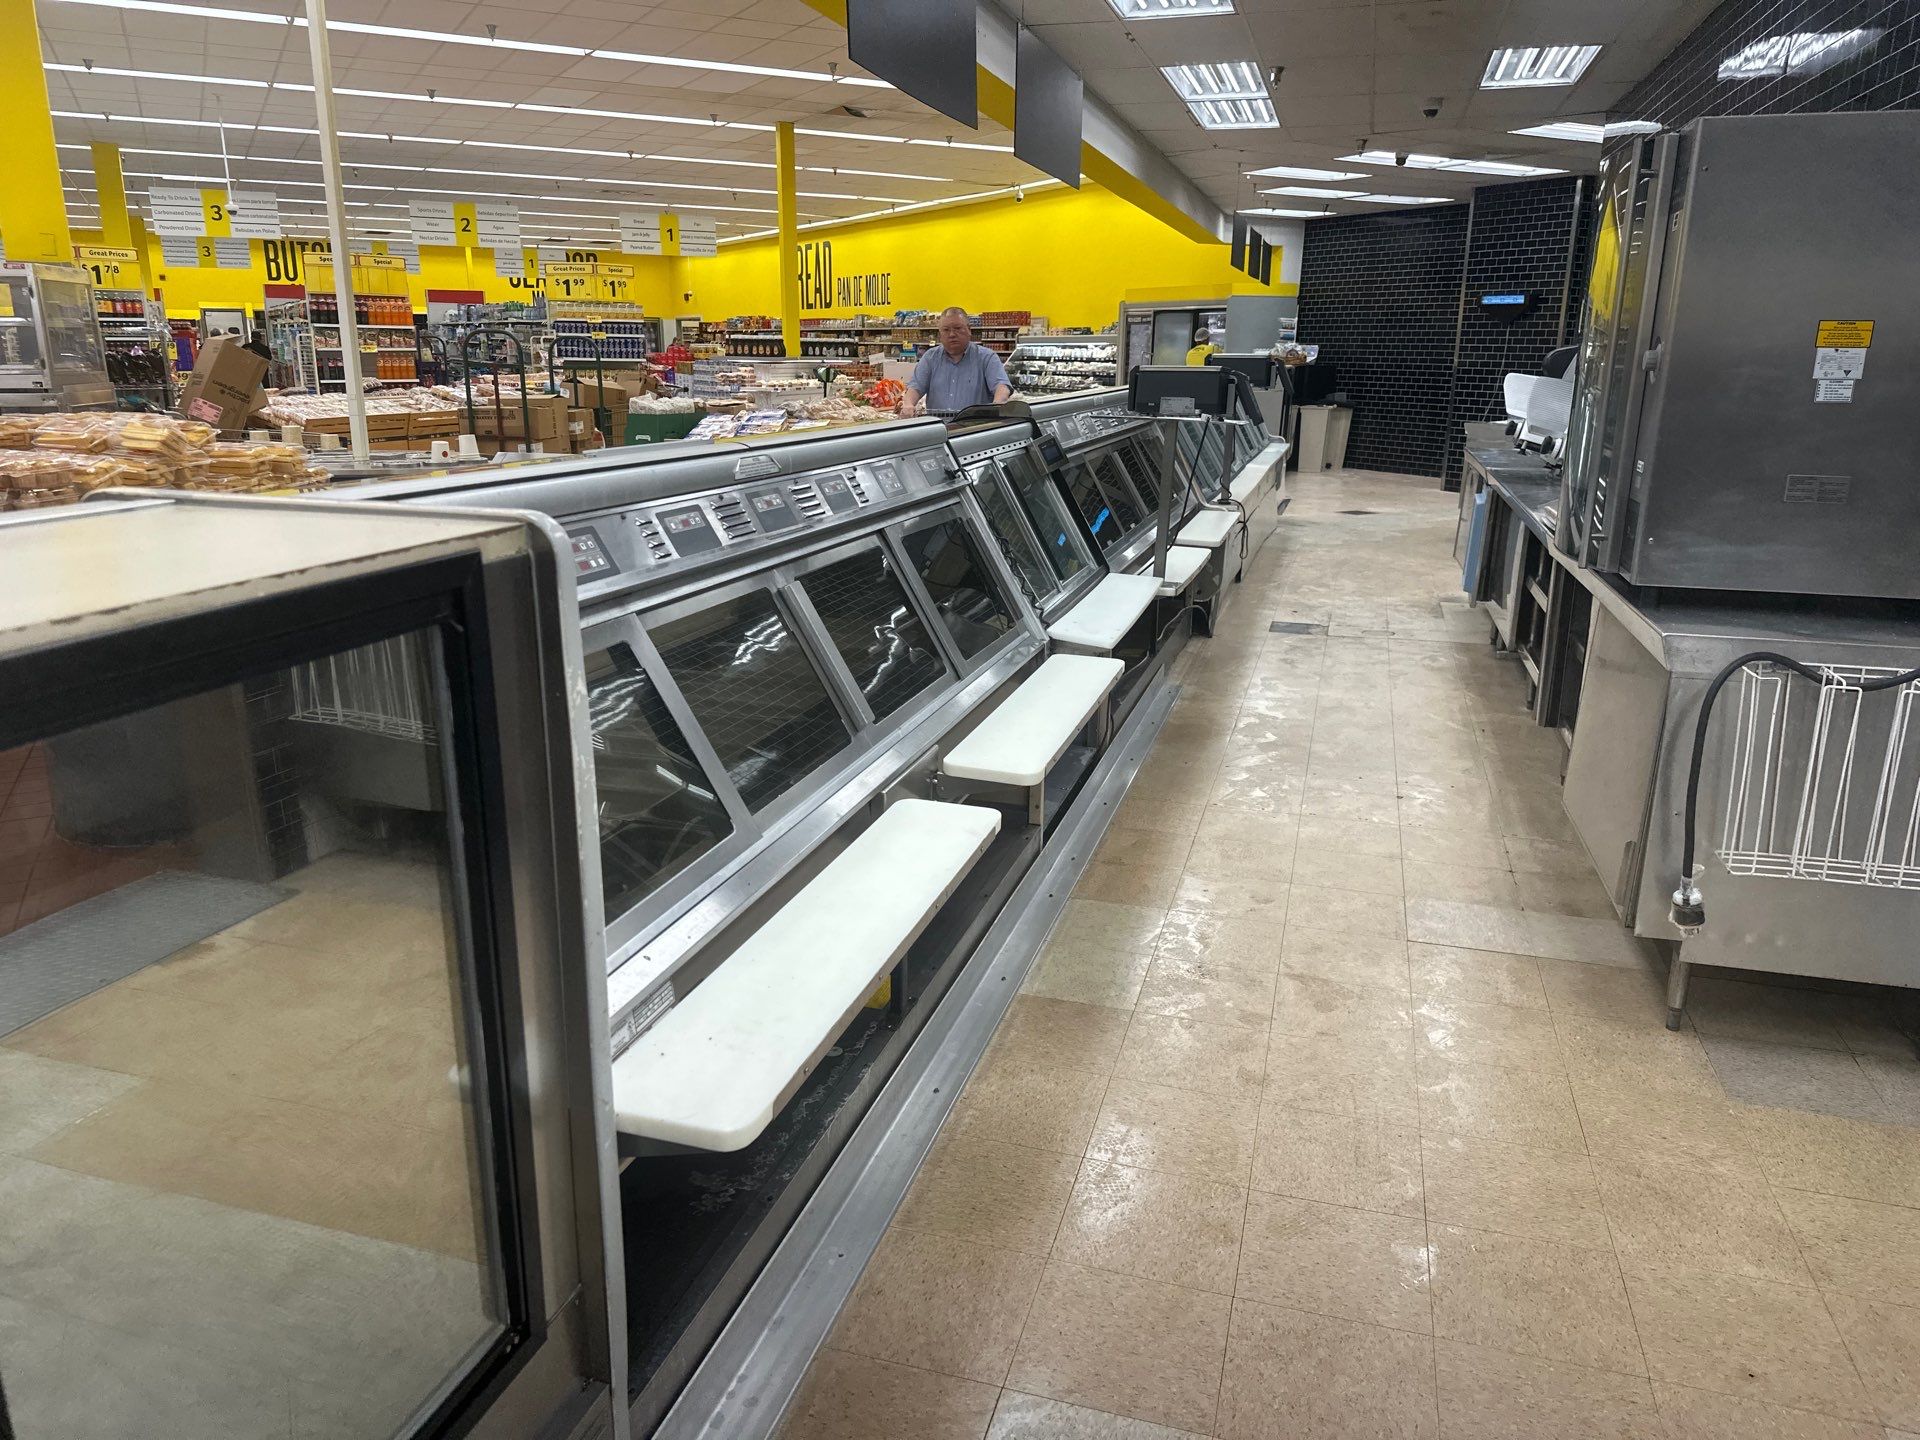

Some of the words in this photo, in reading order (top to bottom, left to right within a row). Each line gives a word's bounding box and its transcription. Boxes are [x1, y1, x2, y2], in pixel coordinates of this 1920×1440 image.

[210, 205, 223, 221] 3
[460, 218, 471, 232] 2
[666, 228, 673, 241] 1
[202, 246, 211, 257] 3
[529, 259, 534, 268] 1
[798, 241, 832, 310] READ
[838, 276, 851, 307] PAN
[854, 276, 862, 306] DE
[866, 273, 891, 306] MOLDE
